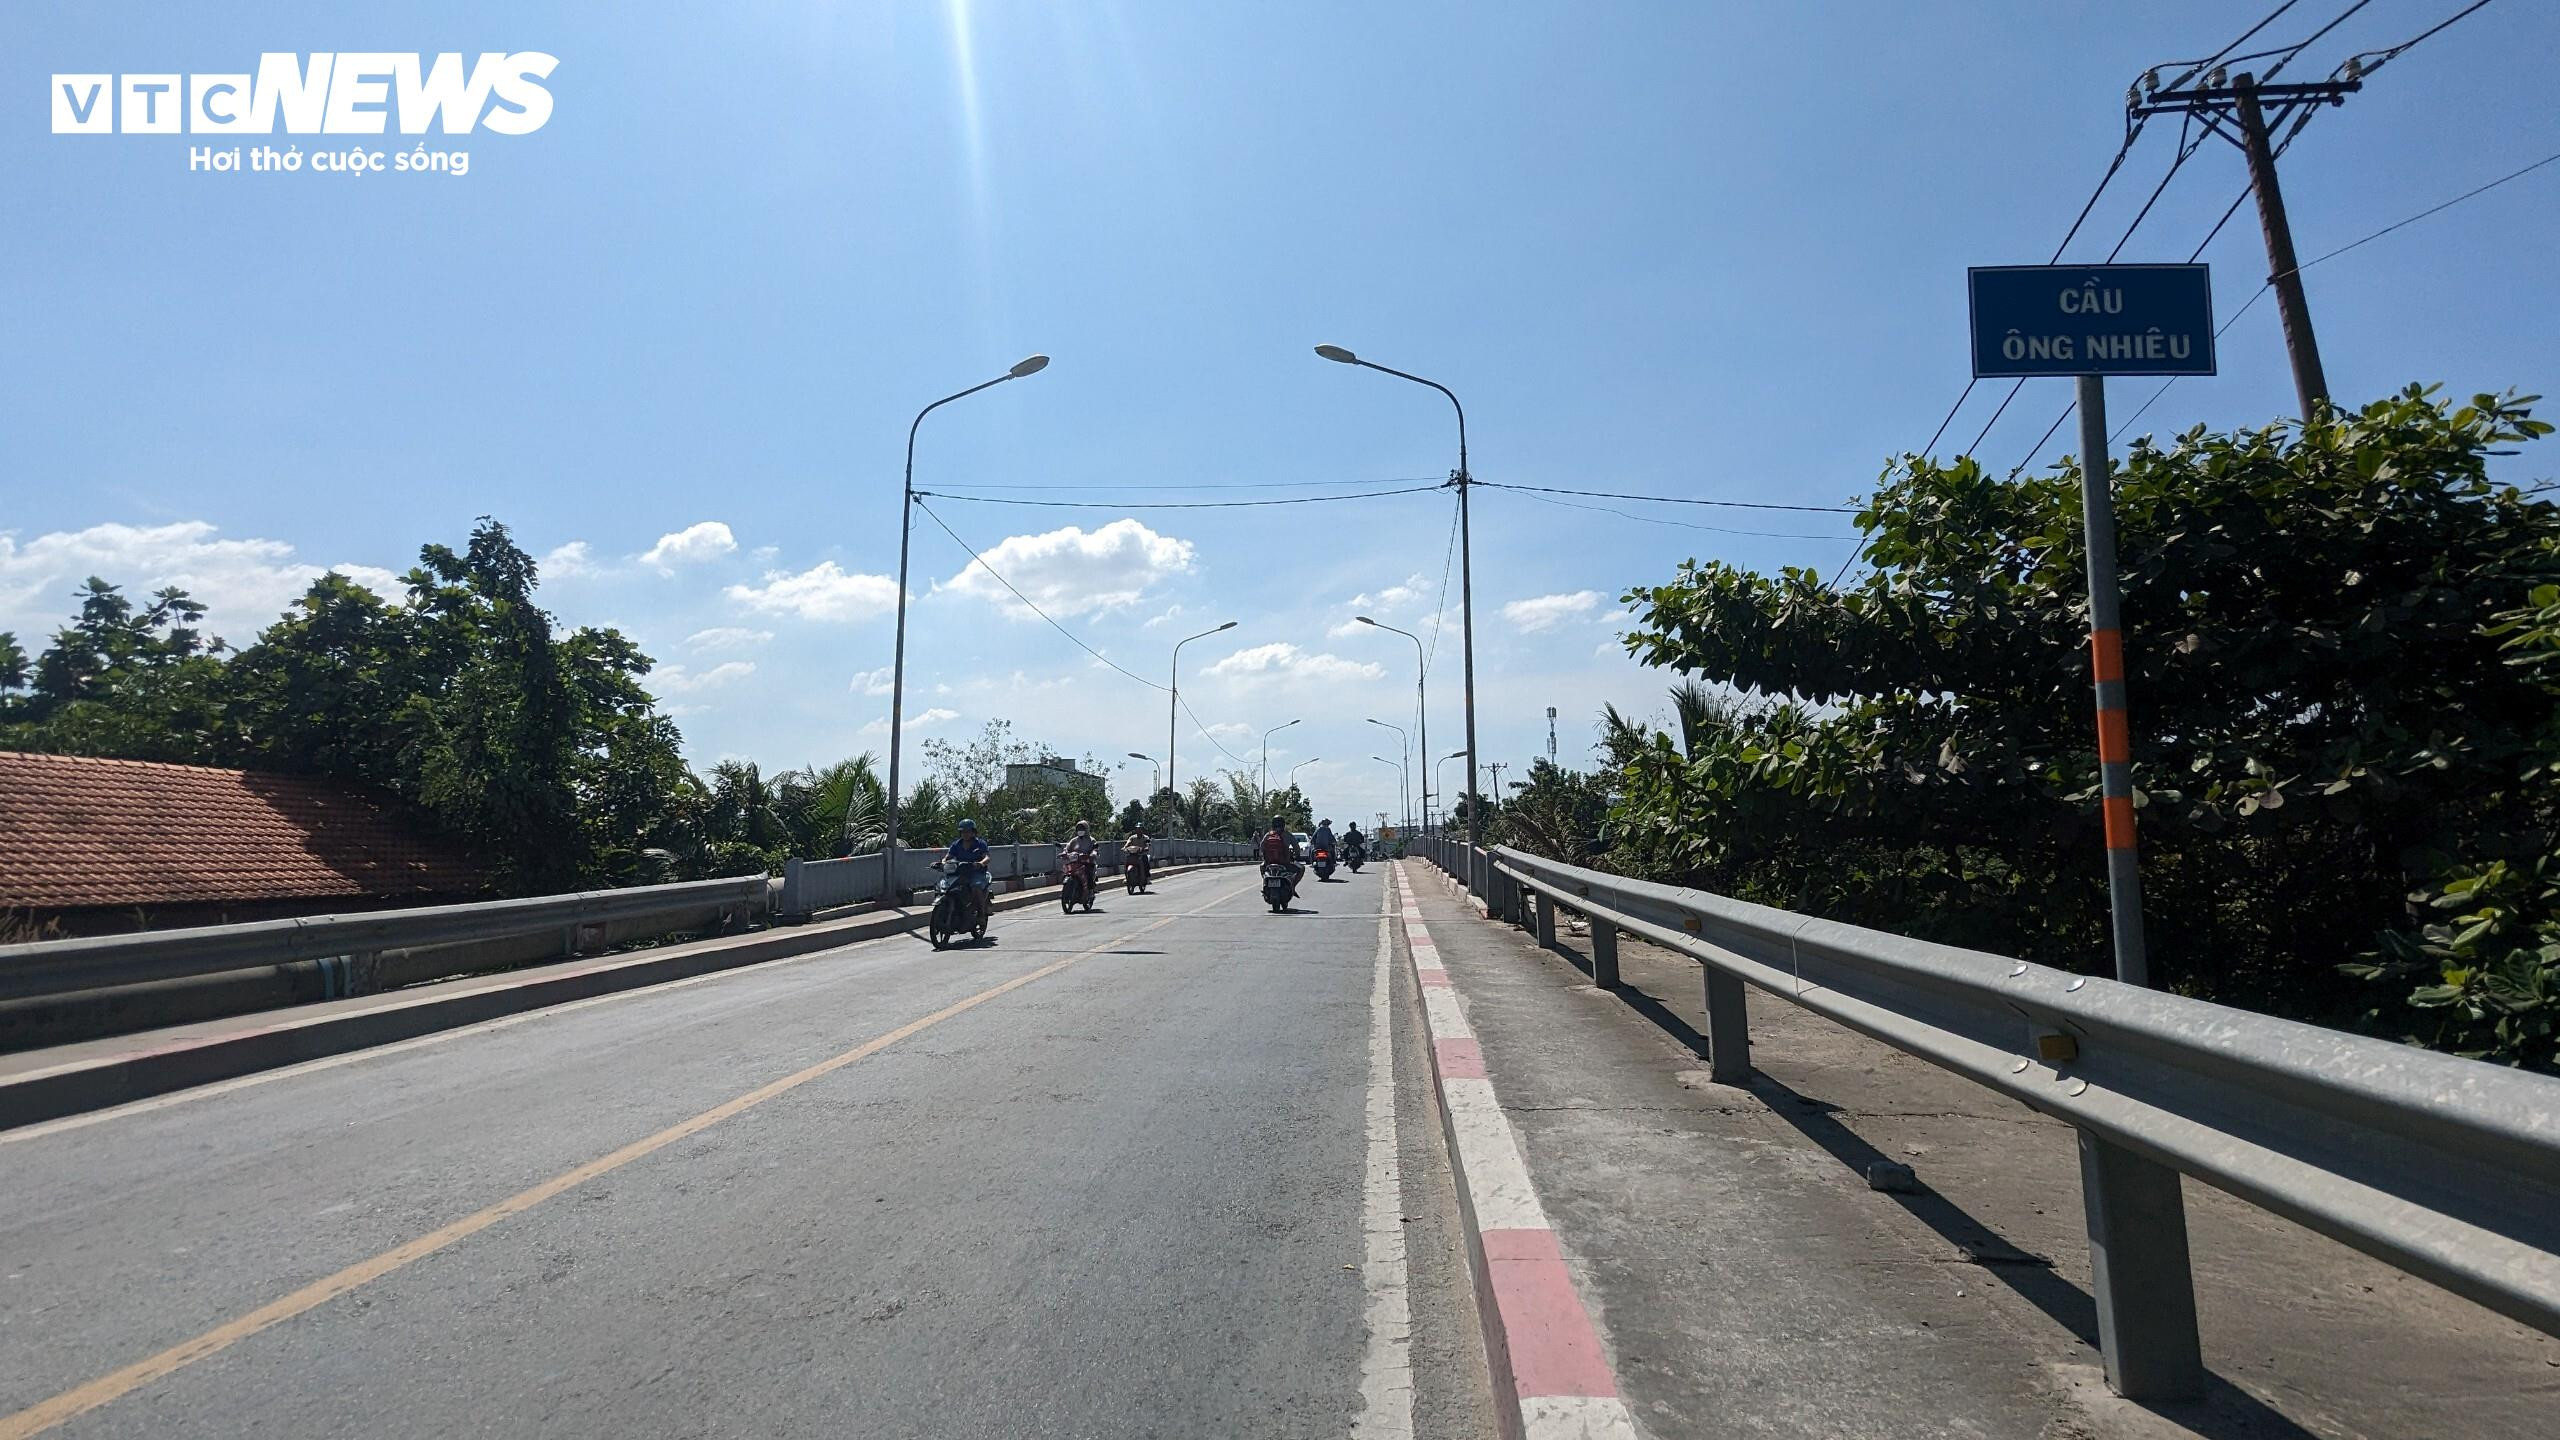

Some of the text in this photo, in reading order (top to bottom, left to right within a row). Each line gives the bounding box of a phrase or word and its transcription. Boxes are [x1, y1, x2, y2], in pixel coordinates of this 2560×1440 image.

[2059, 276, 2123, 314] CẦU
[2003, 327, 2192, 360] ÔNG NHIÊU
